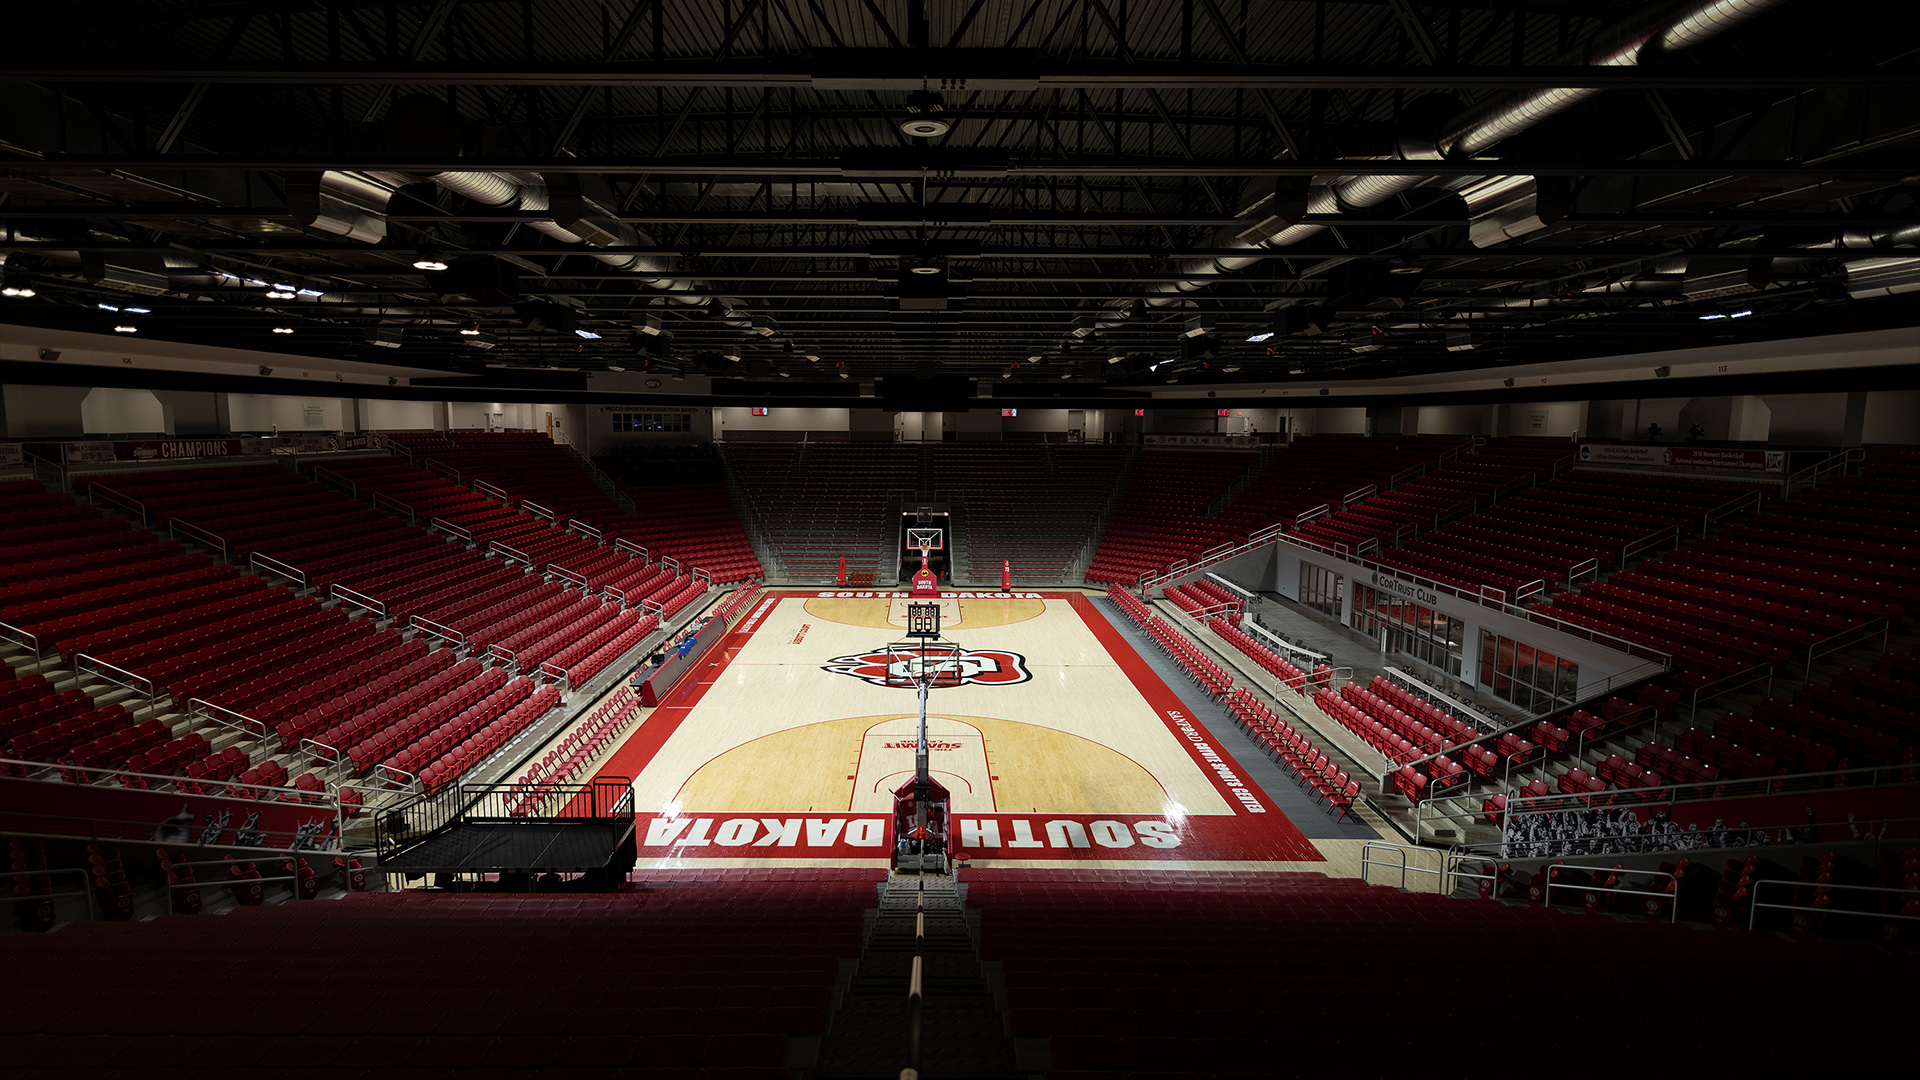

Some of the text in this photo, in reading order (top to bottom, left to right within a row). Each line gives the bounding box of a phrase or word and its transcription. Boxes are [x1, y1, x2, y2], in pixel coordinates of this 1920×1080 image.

[88, 444, 112, 452] BASKETBALL
[133, 448, 158, 457] SUMMIT
[161, 441, 228, 458] CHAMPIONS
[1712, 459, 1738, 467] Tournament
[1738, 460, 1764, 469] Champions
[1166, 710, 1203, 742] SANFORD
[1210, 763, 1244, 787] SPORTS
[1231, 788, 1266, 813] CENTER
[644, 818, 1183, 849] SOUTH DAKOTA
